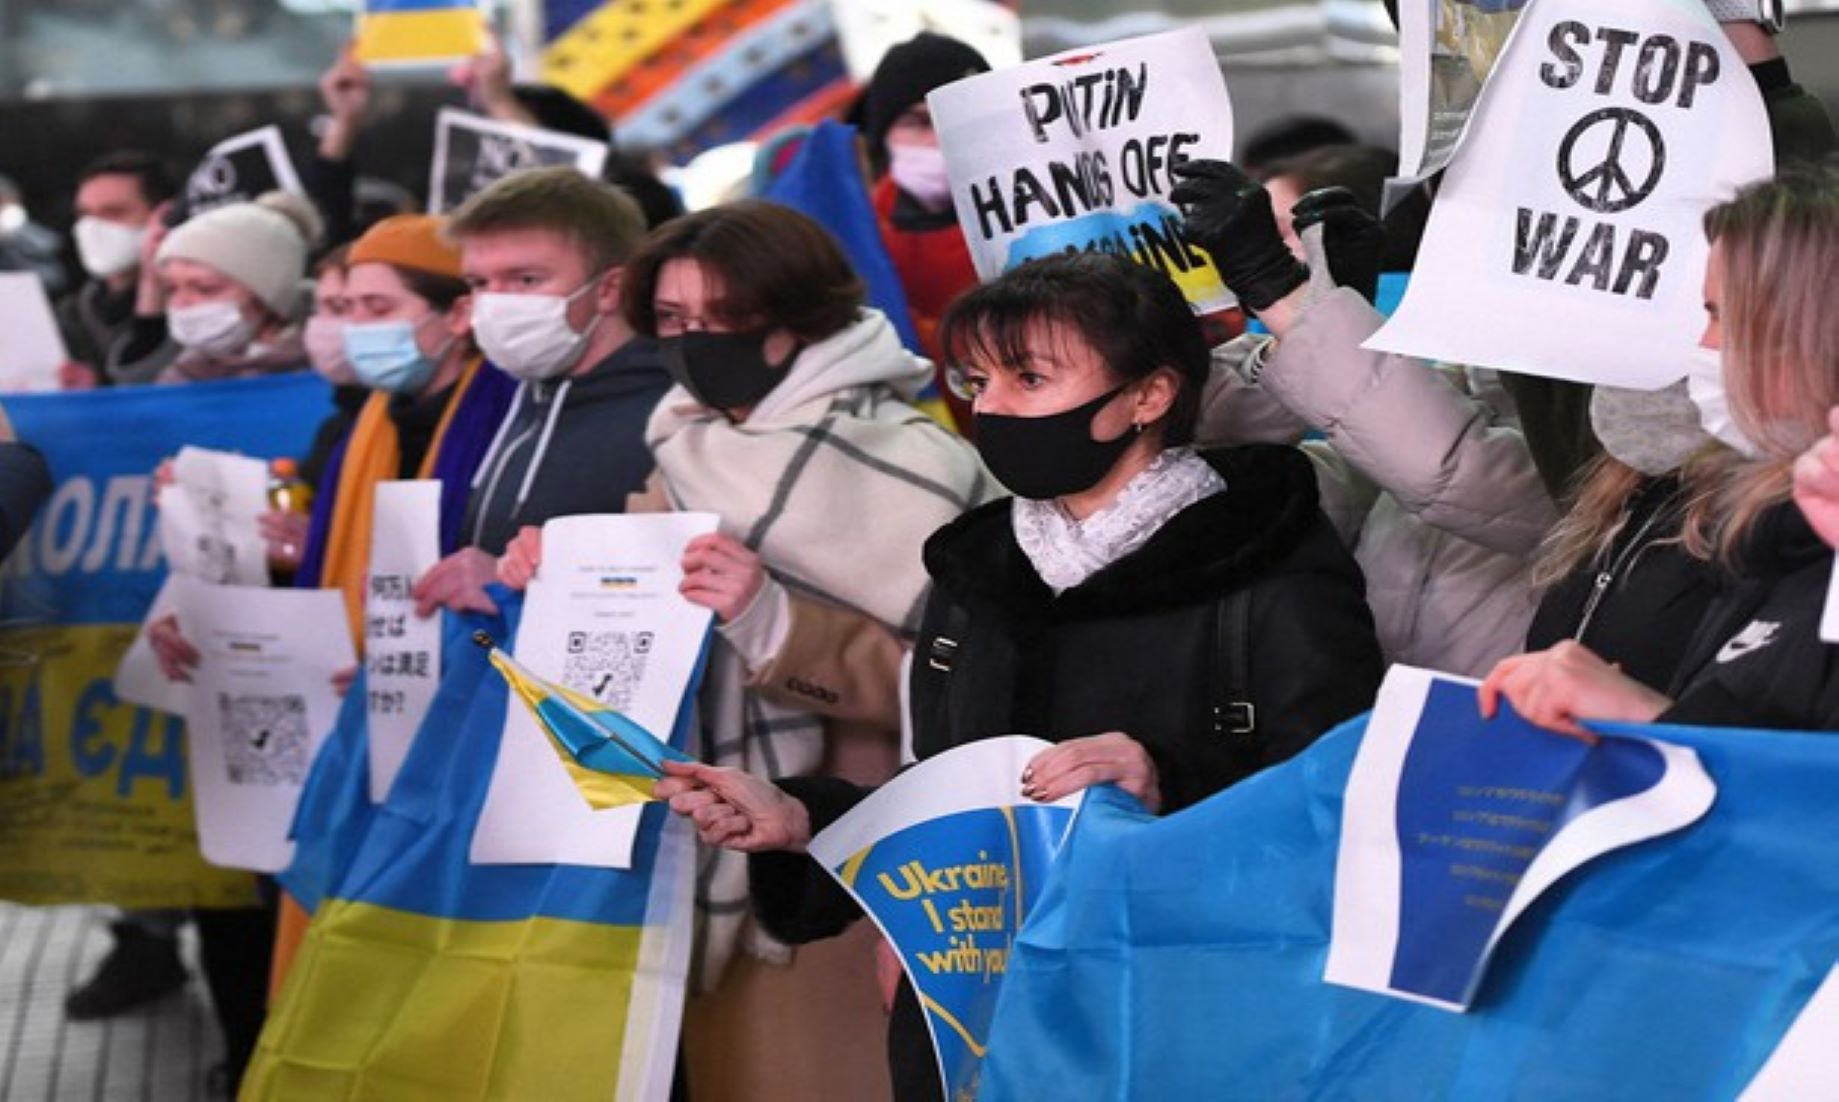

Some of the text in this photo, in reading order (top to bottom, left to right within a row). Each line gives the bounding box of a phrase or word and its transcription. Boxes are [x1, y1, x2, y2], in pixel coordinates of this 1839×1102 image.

[1539, 20, 1721, 108] STOP
[971, 132, 1201, 239] HANDS OFF
[1511, 206, 1670, 300] WAR
[916, 934, 981, 974] with
[921, 899, 944, 934] I
